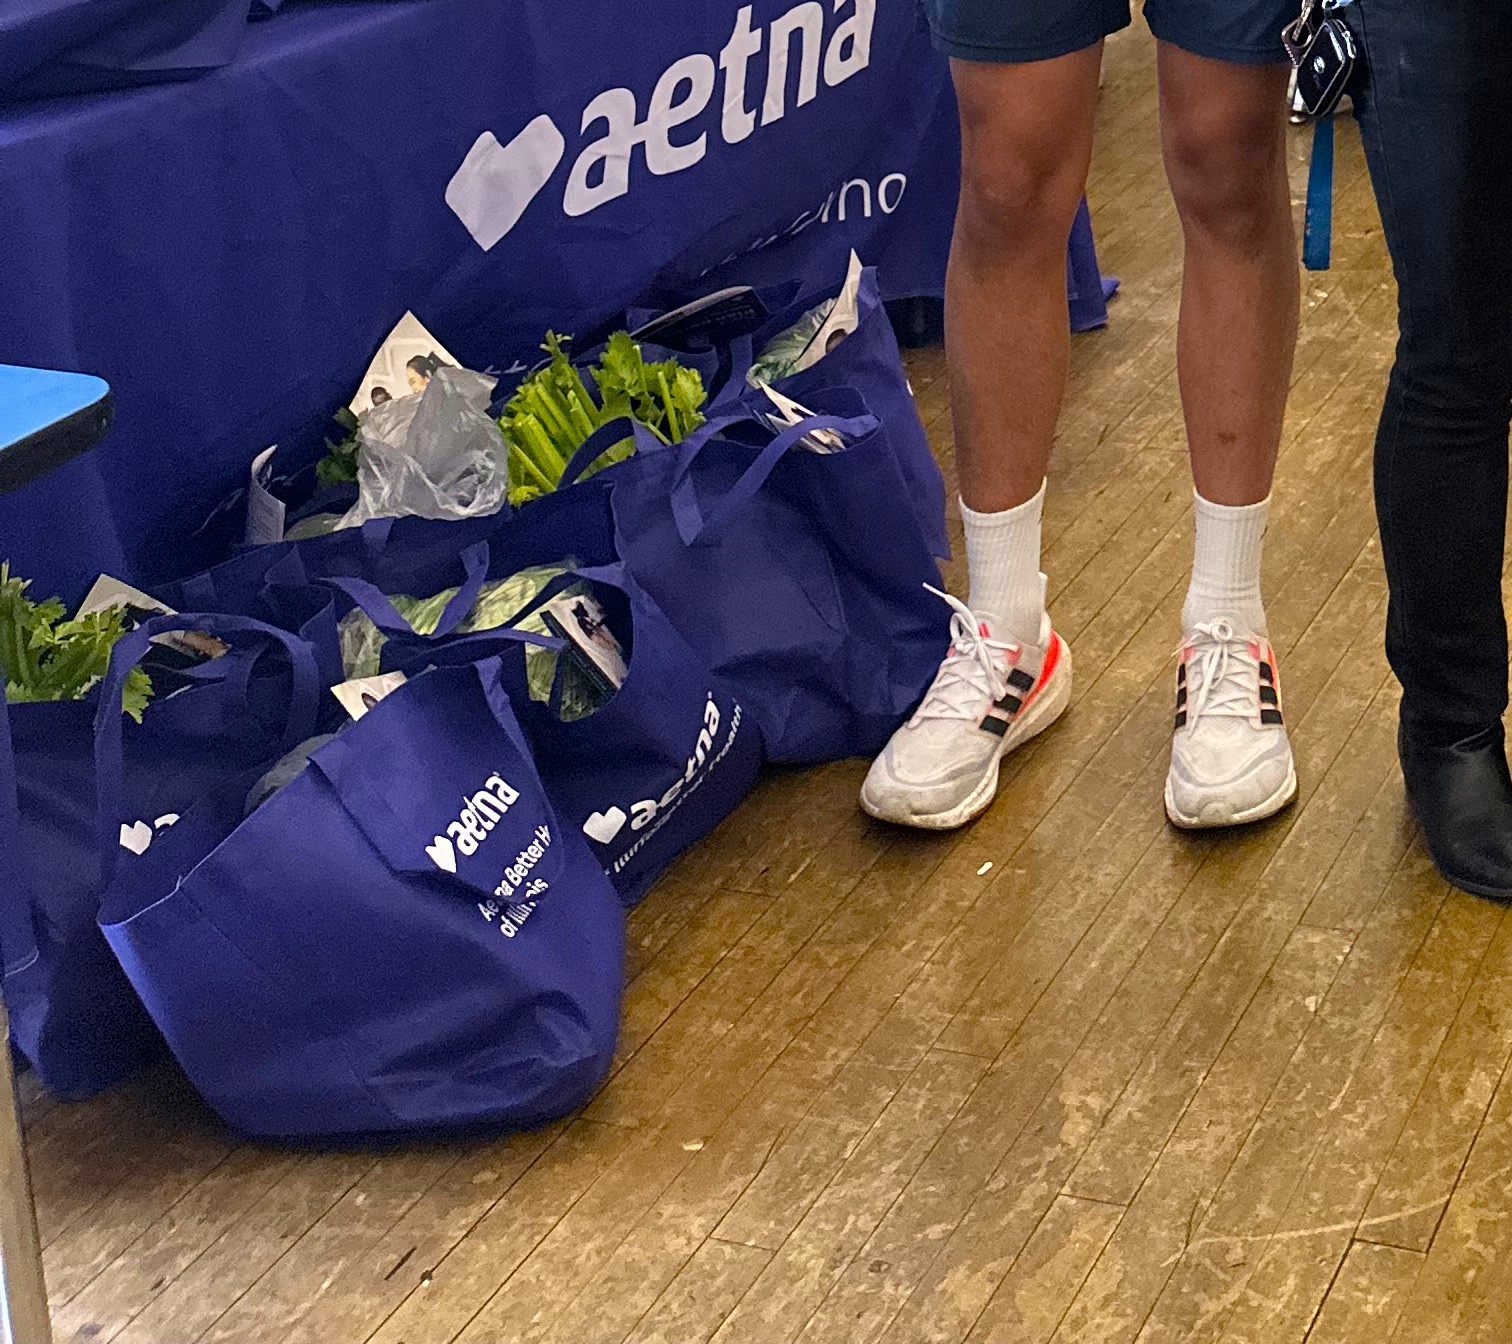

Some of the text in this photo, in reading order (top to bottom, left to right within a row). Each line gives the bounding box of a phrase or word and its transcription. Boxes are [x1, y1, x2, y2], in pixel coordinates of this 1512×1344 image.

[631, 701, 720, 831] aetna
[447, 775, 519, 855] aetna
[506, 841, 544, 885] Better
[500, 922, 516, 937] of
